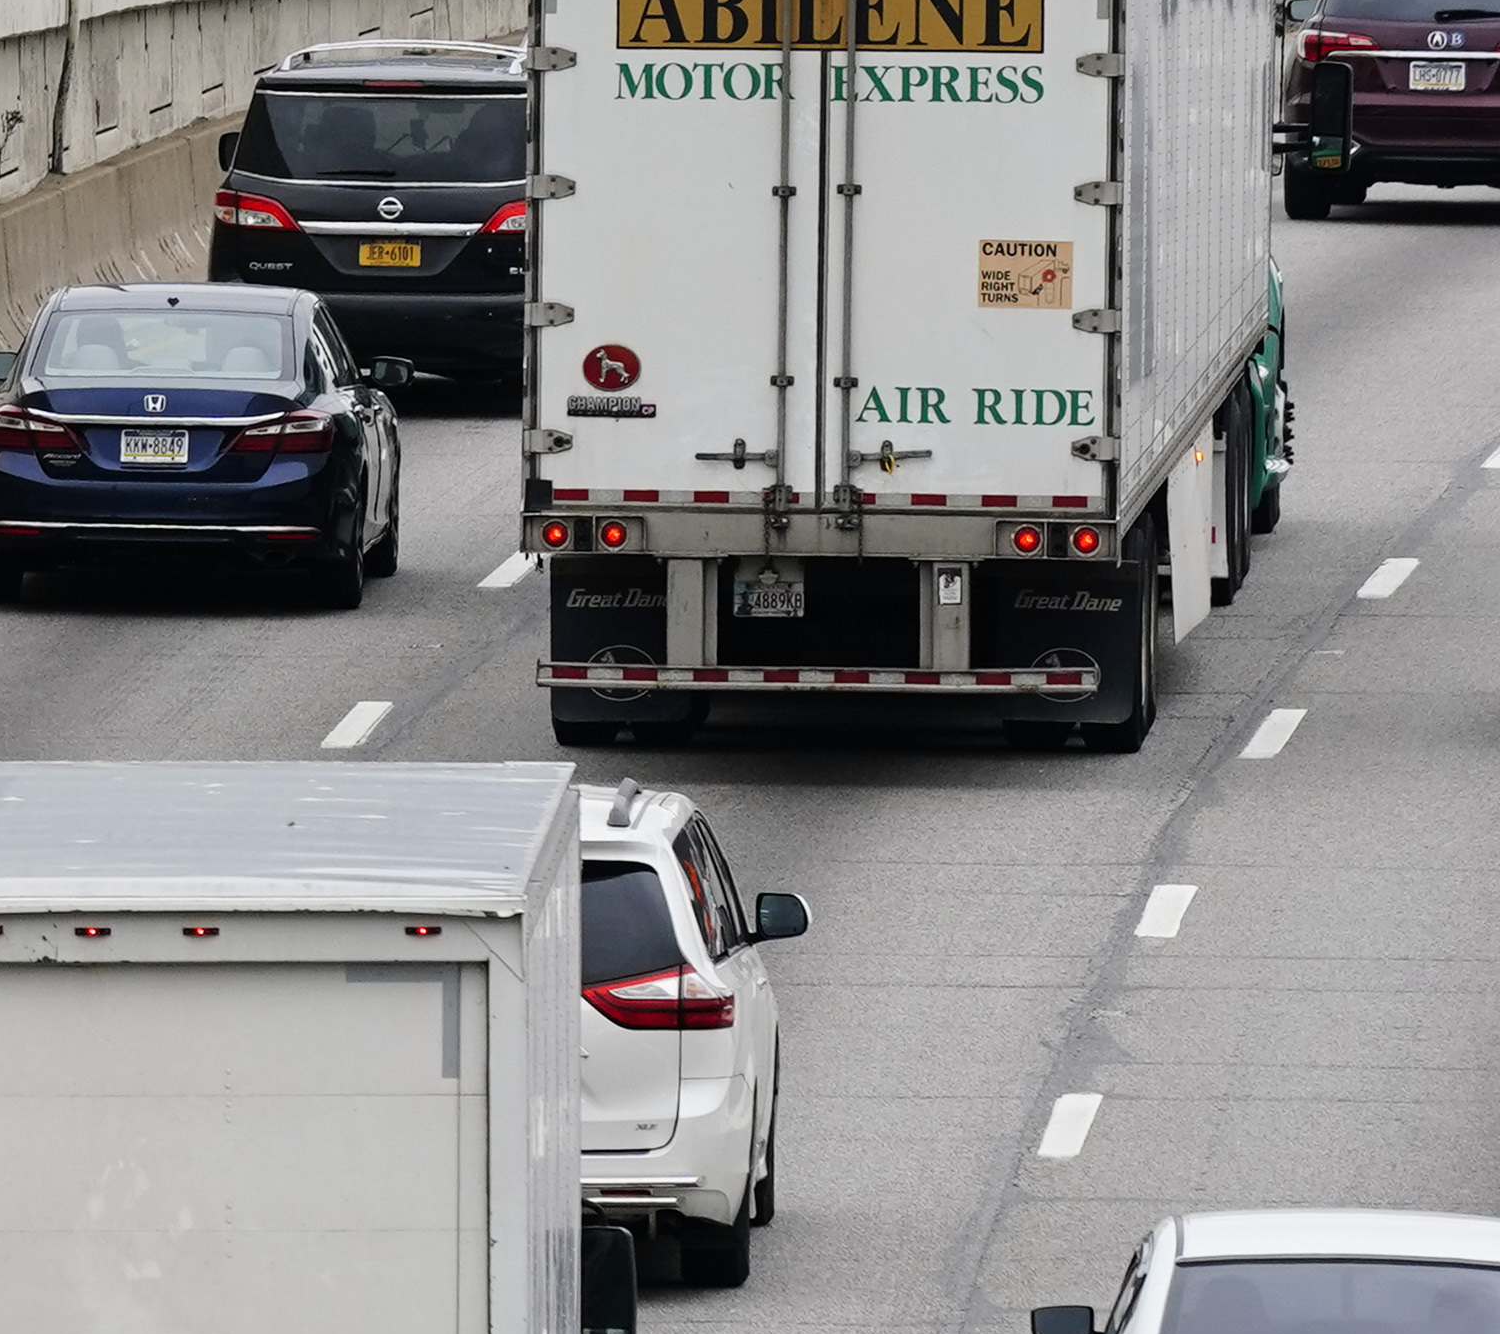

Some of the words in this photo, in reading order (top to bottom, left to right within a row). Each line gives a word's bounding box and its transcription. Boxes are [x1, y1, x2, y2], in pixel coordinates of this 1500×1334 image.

[614, 62, 796, 103] MOTOR
[829, 65, 1045, 105] EXPRESS
[982, 242, 1058, 257] CAUTION
[248, 261, 294, 271] QUEST
[981, 270, 1011, 281] WIDE
[981, 282, 1016, 292] RIGHT
[981, 293, 1019, 303] TURNS
[567, 395, 642, 411] CHAMPION
[855, 385, 952, 425] AIR
[971, 387, 1096, 427] RIDE
[565, 587, 625, 608] Great
[1013, 589, 1070, 610] Great
[1070, 591, 1123, 612] Dane
